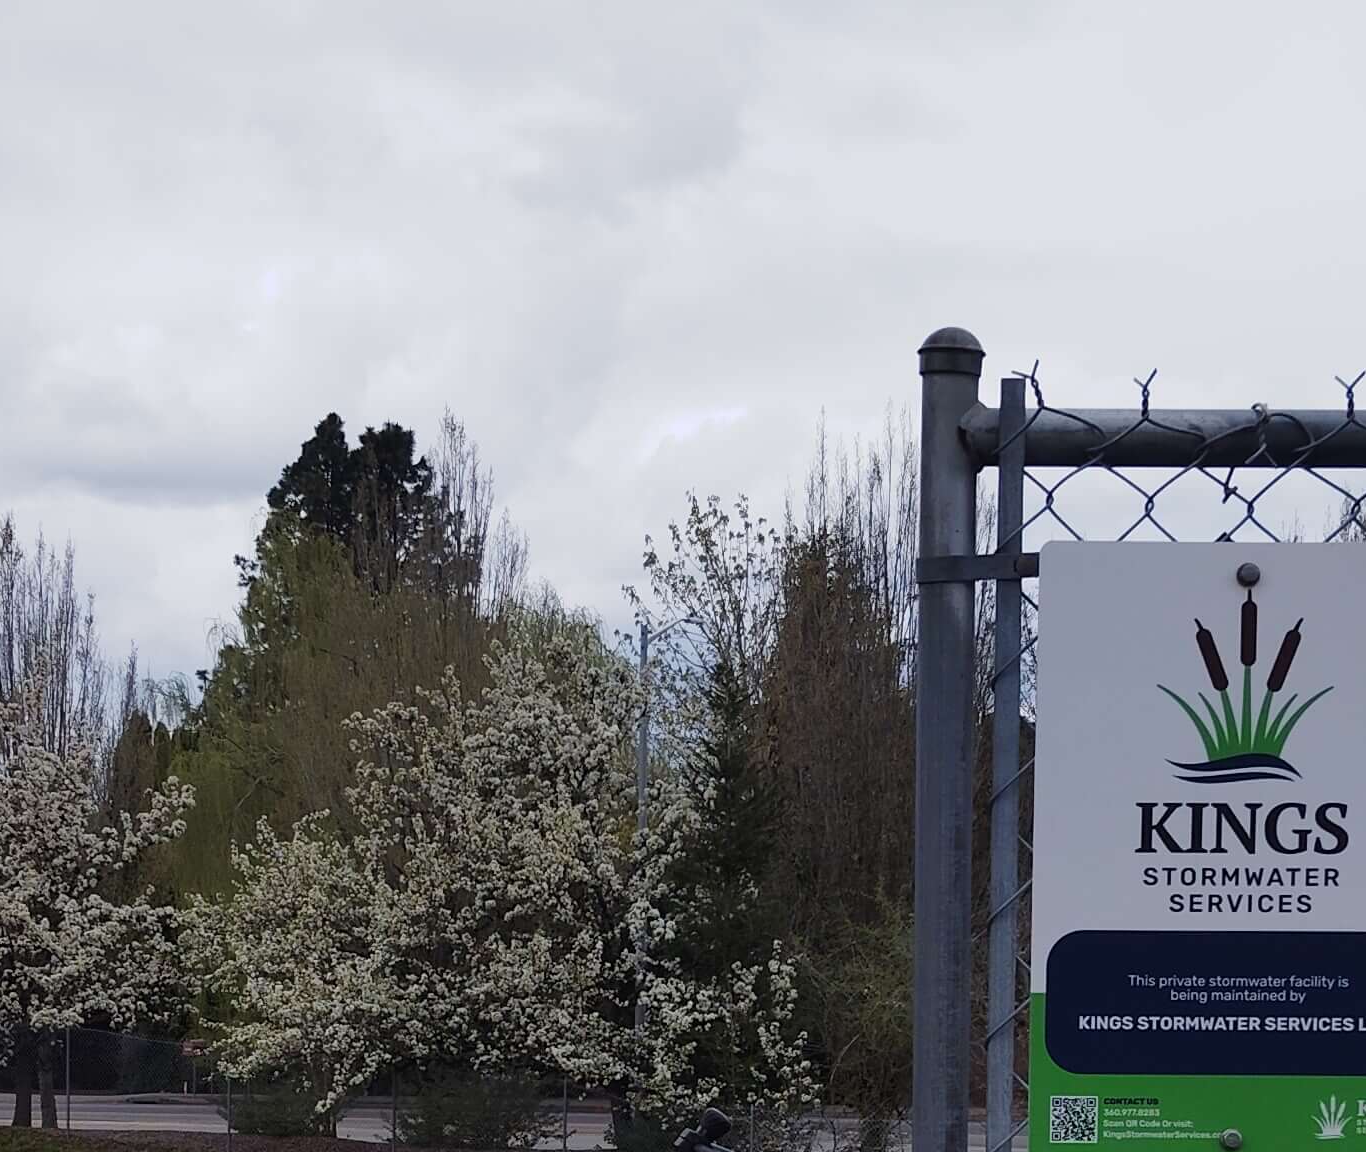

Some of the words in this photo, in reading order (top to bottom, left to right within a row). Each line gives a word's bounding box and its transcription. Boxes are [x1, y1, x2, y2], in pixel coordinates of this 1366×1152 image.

[1134, 802, 1349, 855] KINGS
[1142, 867, 1340, 887] STORMWATER
[1169, 893, 1312, 913] SERVICES
[1128, 974, 1156, 986] This
[1159, 974, 1205, 989] private
[1208, 975, 1287, 987] stormwater
[1289, 975, 1335, 990] facility
[1338, 976, 1349, 987] is
[1170, 989, 1208, 1004] being
[1210, 989, 1286, 1001] maintained
[1289, 990, 1307, 1004] by
[1078, 1015, 1134, 1030] KINGS
[1137, 1016, 1261, 1031] STORMWATER
[1264, 1017, 1355, 1032] SERVICES
[1104, 1097, 1145, 1105] CONTACT
[1138, 1119, 1161, 1128] Code
